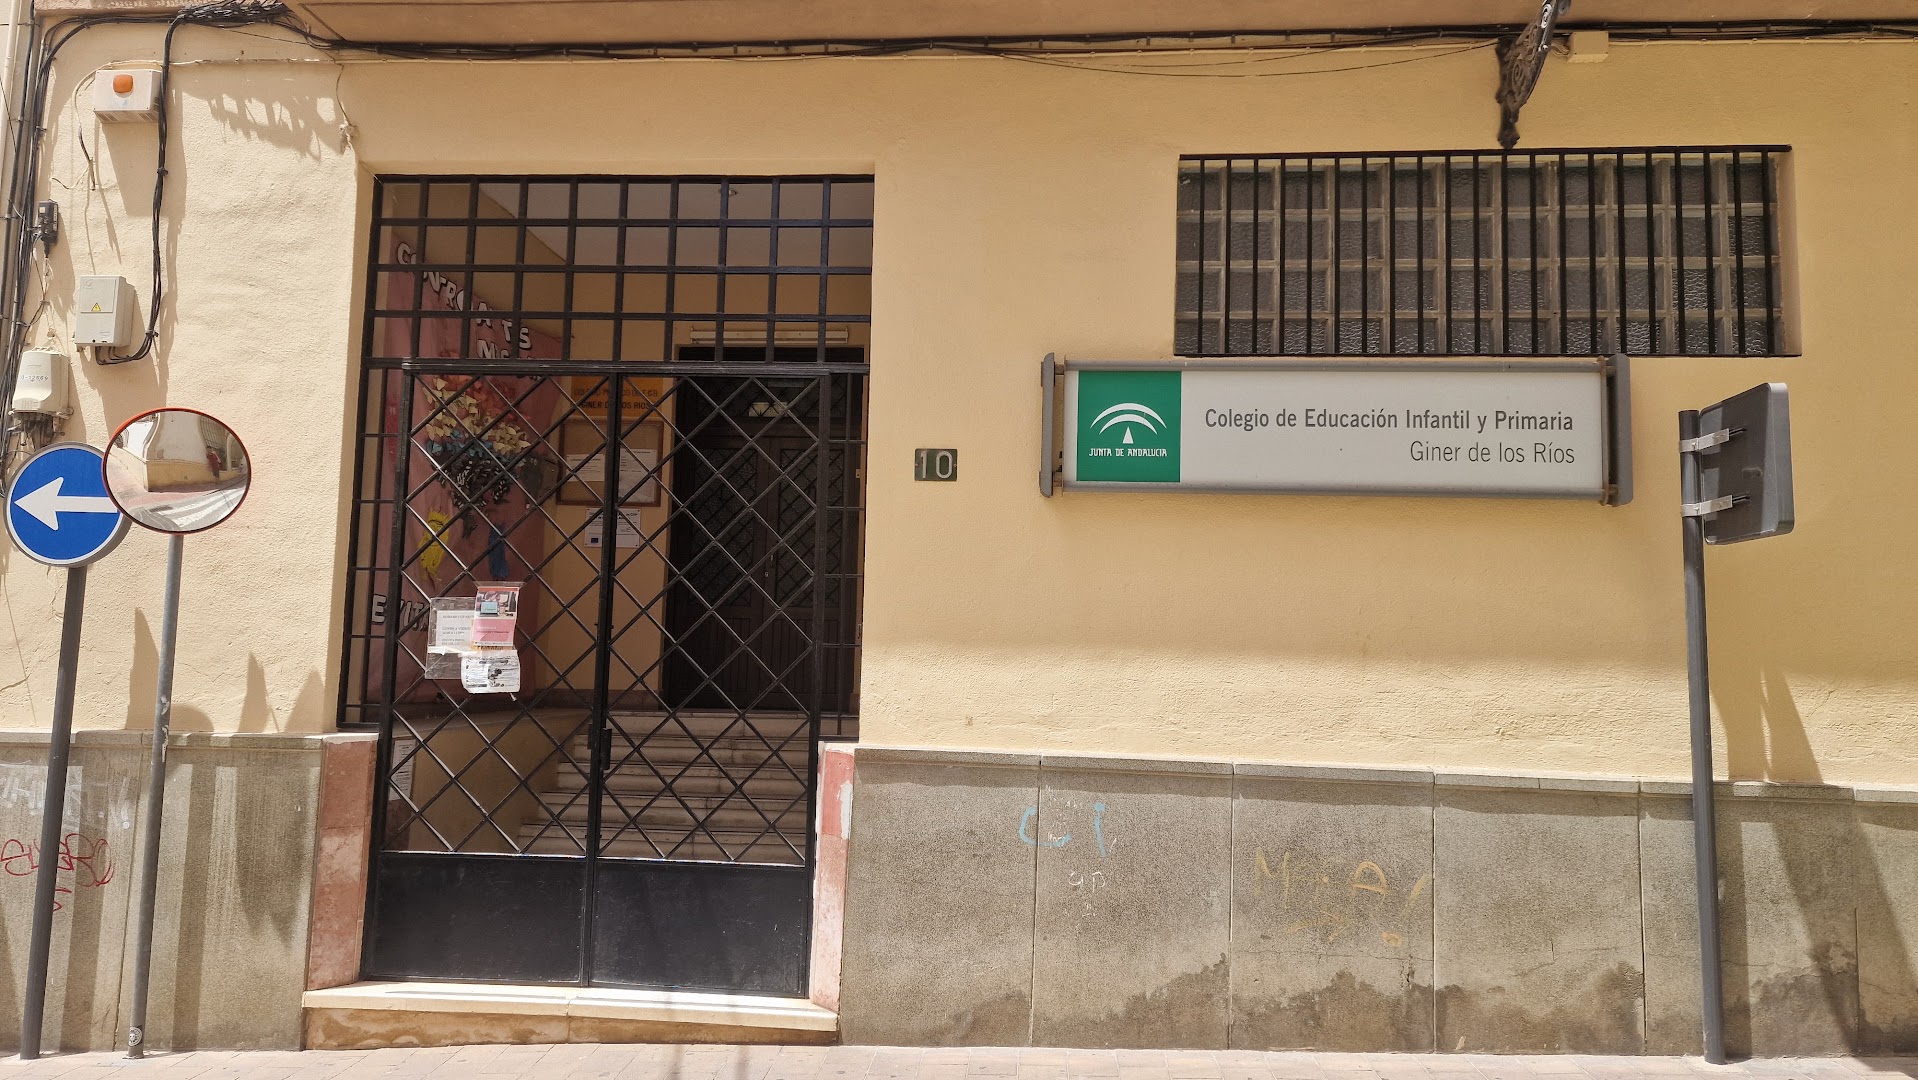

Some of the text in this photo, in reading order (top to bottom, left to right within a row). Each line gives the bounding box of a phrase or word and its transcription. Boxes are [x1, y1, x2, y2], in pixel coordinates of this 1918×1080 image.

[1205, 408, 1573, 434] Colegio de Educación Infantil y Primaria
[920, 450, 953, 479] 10
[1089, 448, 1167, 457] JUNTA DE ANDALUCIA
[1410, 441, 1575, 464] Giner de los Ríos
